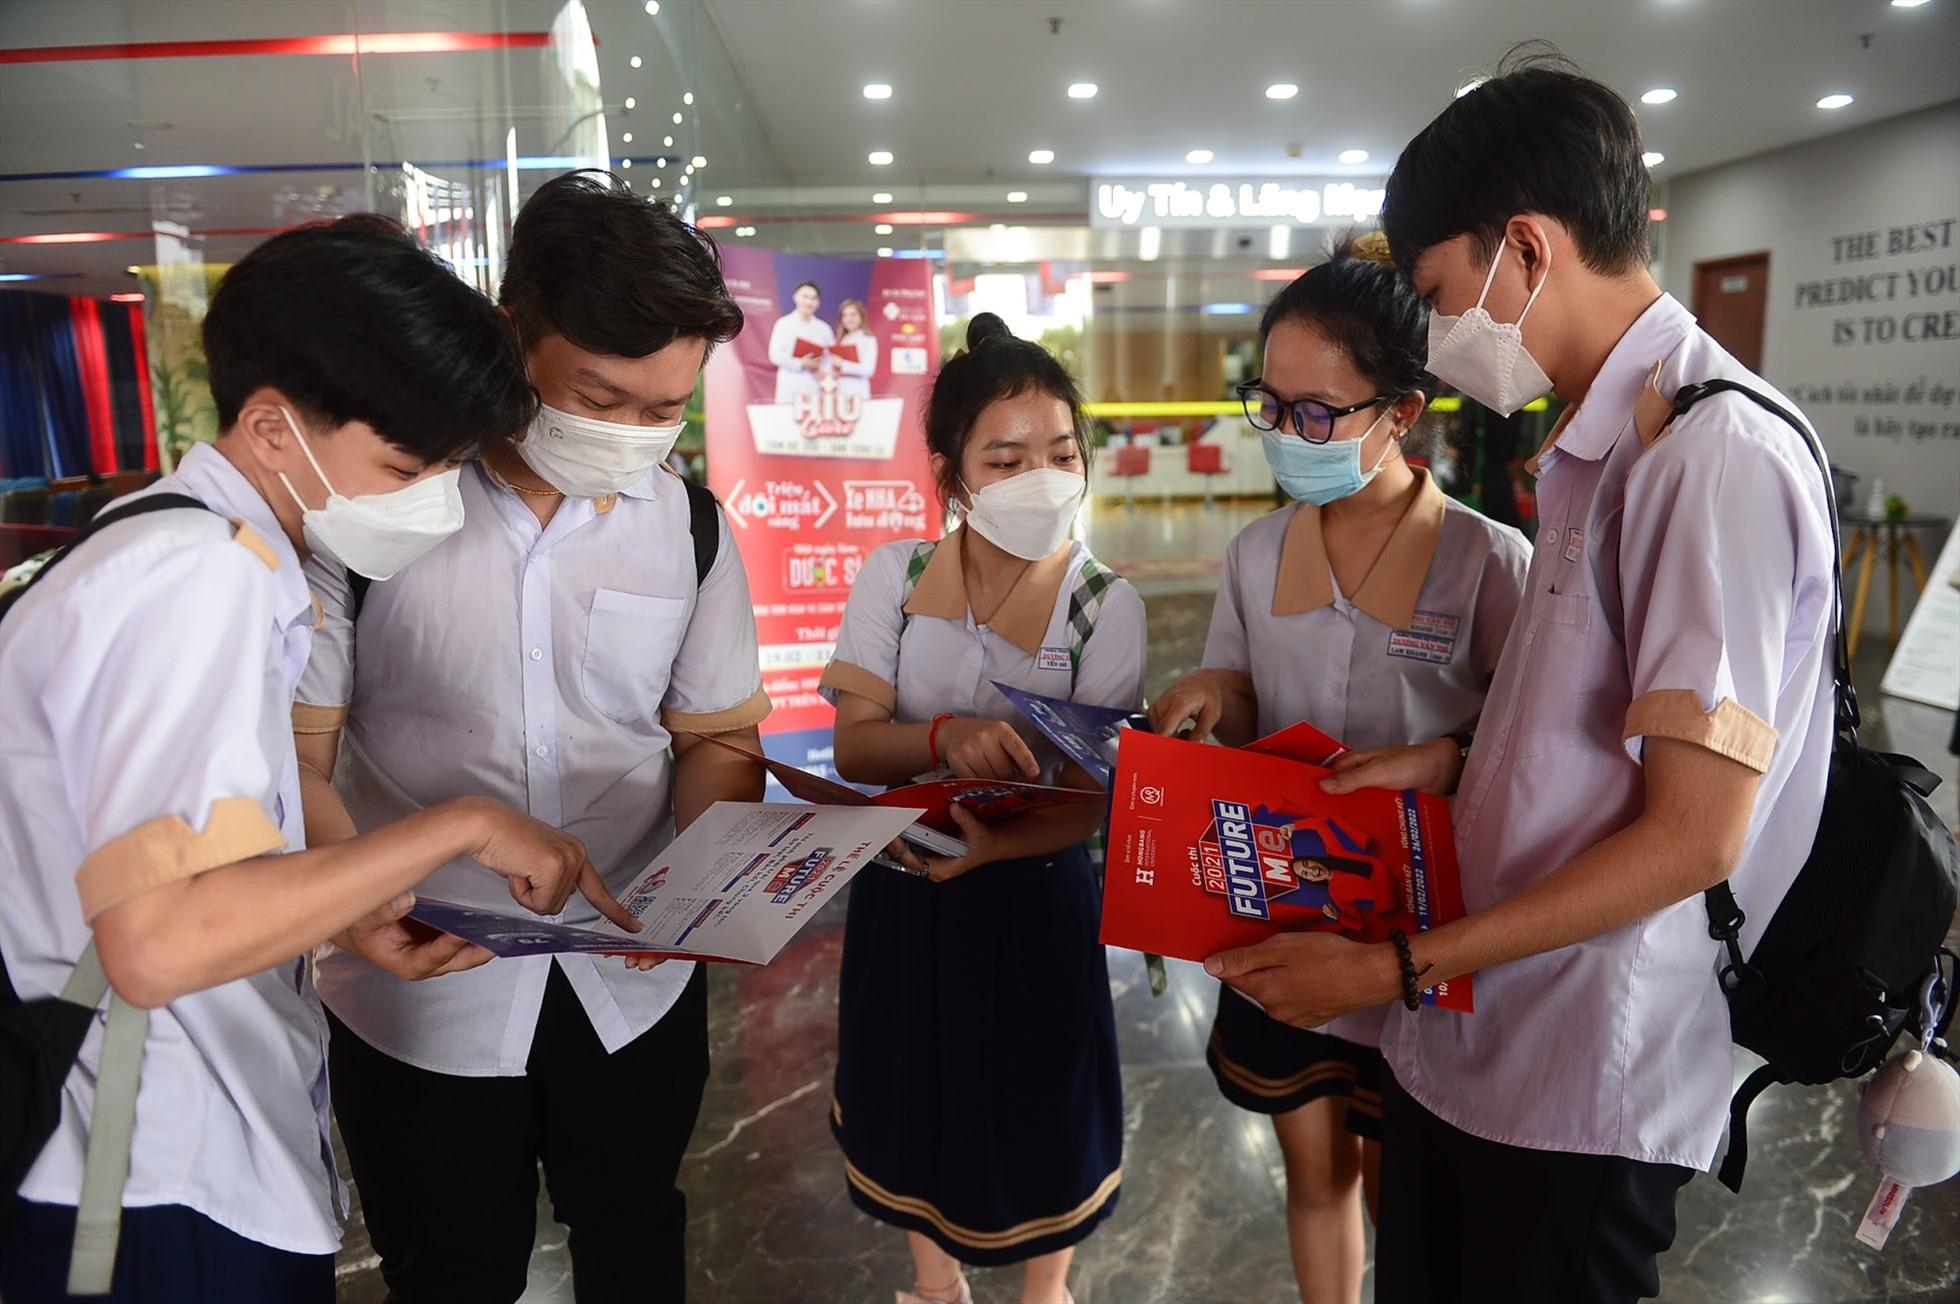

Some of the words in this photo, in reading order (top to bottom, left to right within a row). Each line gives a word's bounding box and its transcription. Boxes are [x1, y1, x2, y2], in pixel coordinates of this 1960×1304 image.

[1099, 184, 1145, 224] Uy
[1206, 184, 1236, 217] &
[1833, 232, 1880, 264] THE
[1887, 219, 1957, 256] BEST
[1796, 271, 1898, 308] PREDICT
[1833, 317, 1854, 345] IS
[1863, 314, 1896, 345] TO
[1408, 808, 1422, 852] 26/02/2022
[1187, 846, 1198, 860] thi
[1204, 847, 1225, 890] 2021
[1219, 803, 1262, 916] FUTURE
[774, 851, 826, 903] FUTURE
[804, 874, 836, 900] CUỘC
[1190, 863, 1202, 886] Cuộc
[1416, 868, 1428, 916] 19/02/2022
[785, 902, 808, 919] THI
